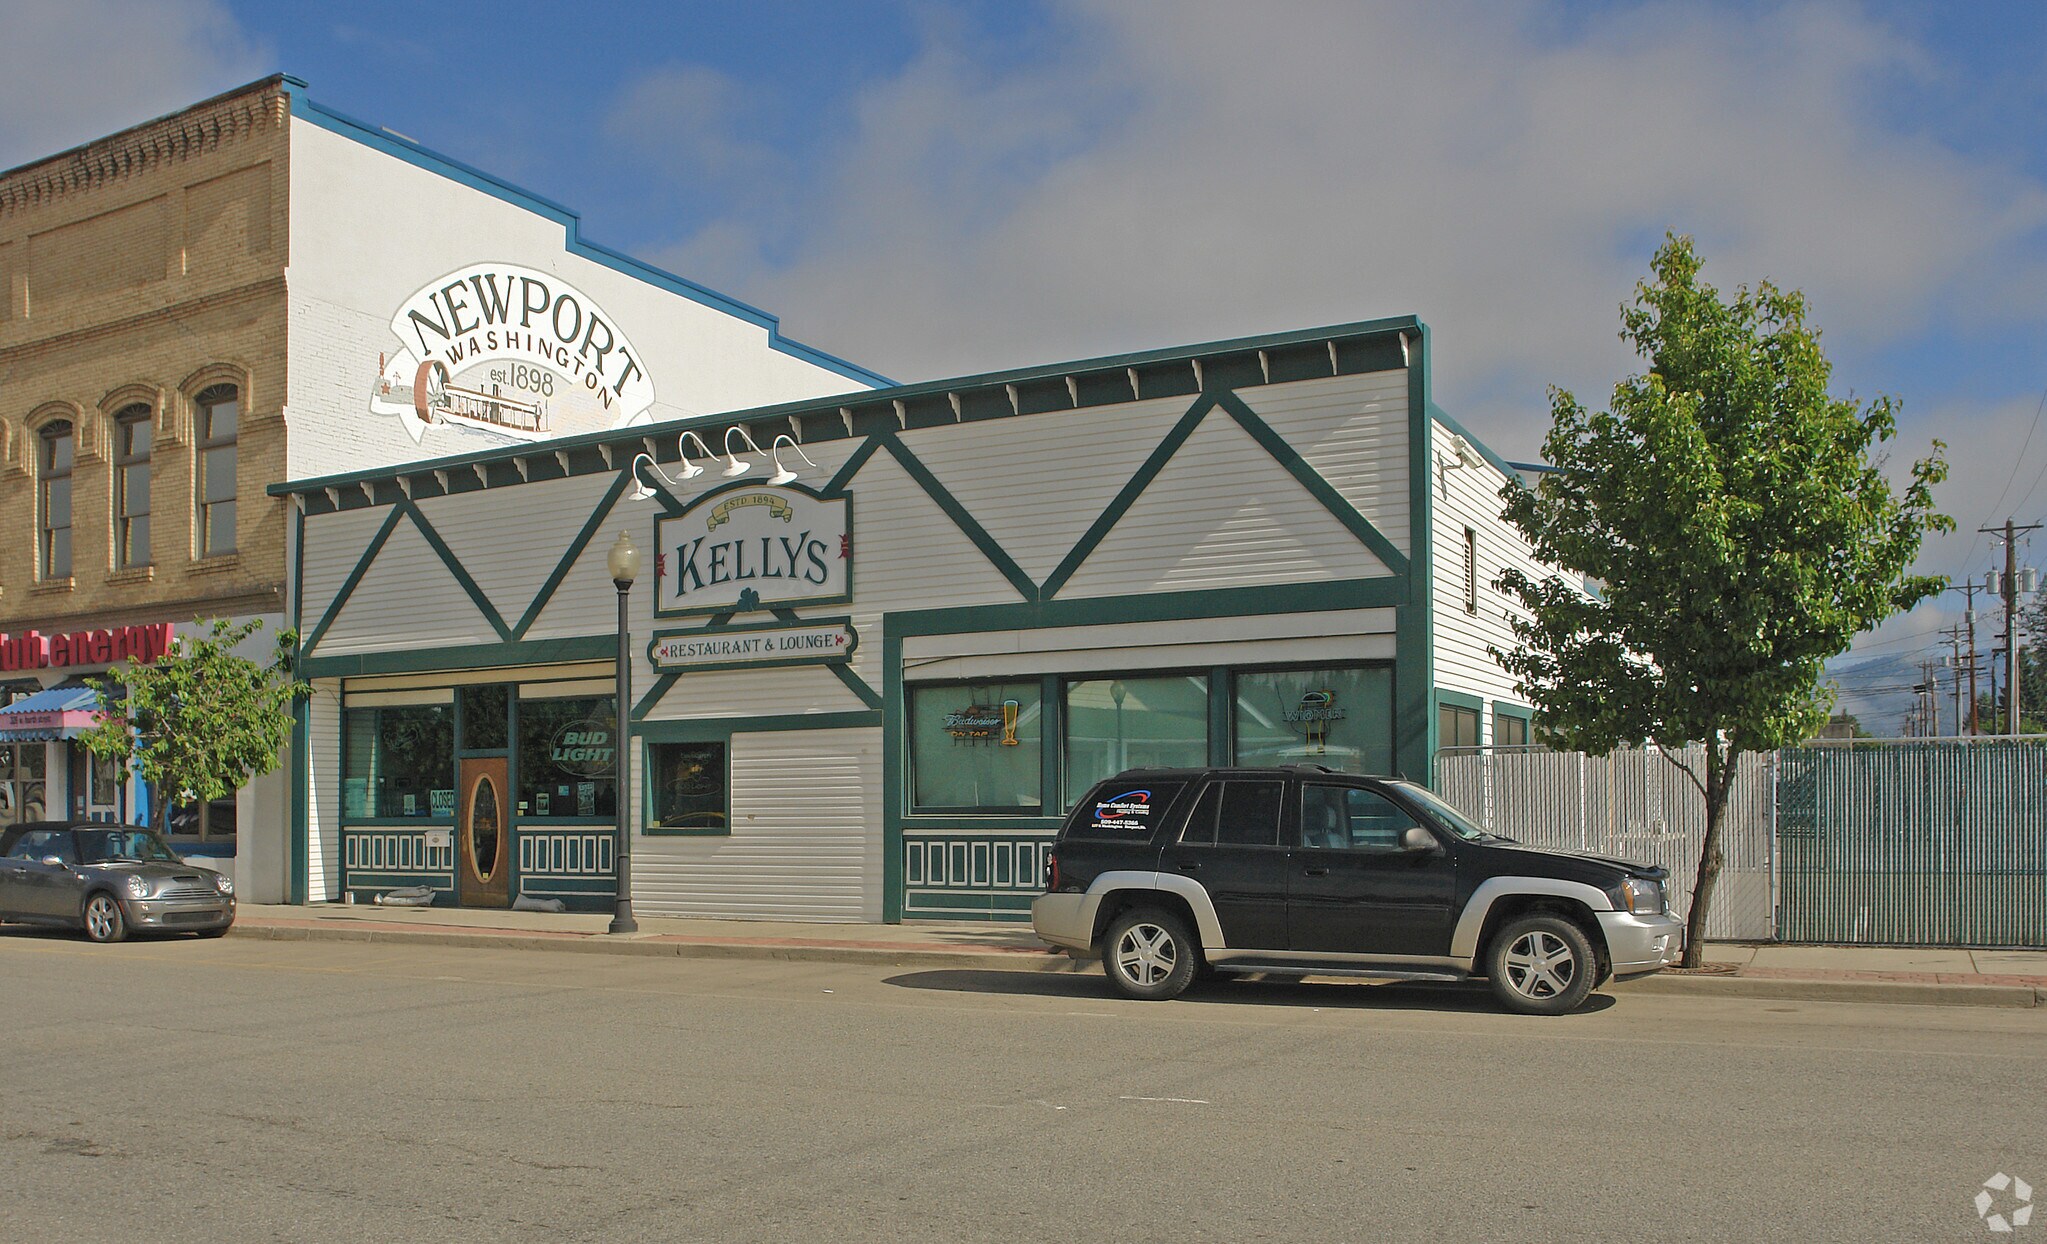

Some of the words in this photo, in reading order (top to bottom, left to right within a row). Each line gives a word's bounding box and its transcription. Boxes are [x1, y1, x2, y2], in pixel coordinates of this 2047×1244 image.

[407, 273, 642, 398] NEWPORT
[445, 330, 613, 410] WASHINGTON
[490, 367, 510, 387] est.
[510, 362, 554, 397] 1898
[675, 530, 829, 599] KELLYS
[50, 623, 174, 667] energy
[669, 638, 761, 658] RESTAURANT
[764, 638, 776, 651] &
[779, 634, 833, 651] LOUNGE
[944, 714, 1001, 727] Budweiser
[562, 731, 609, 745] BUD
[551, 747, 615, 762] LIGHT
[431, 790, 455, 809] CLOSED
